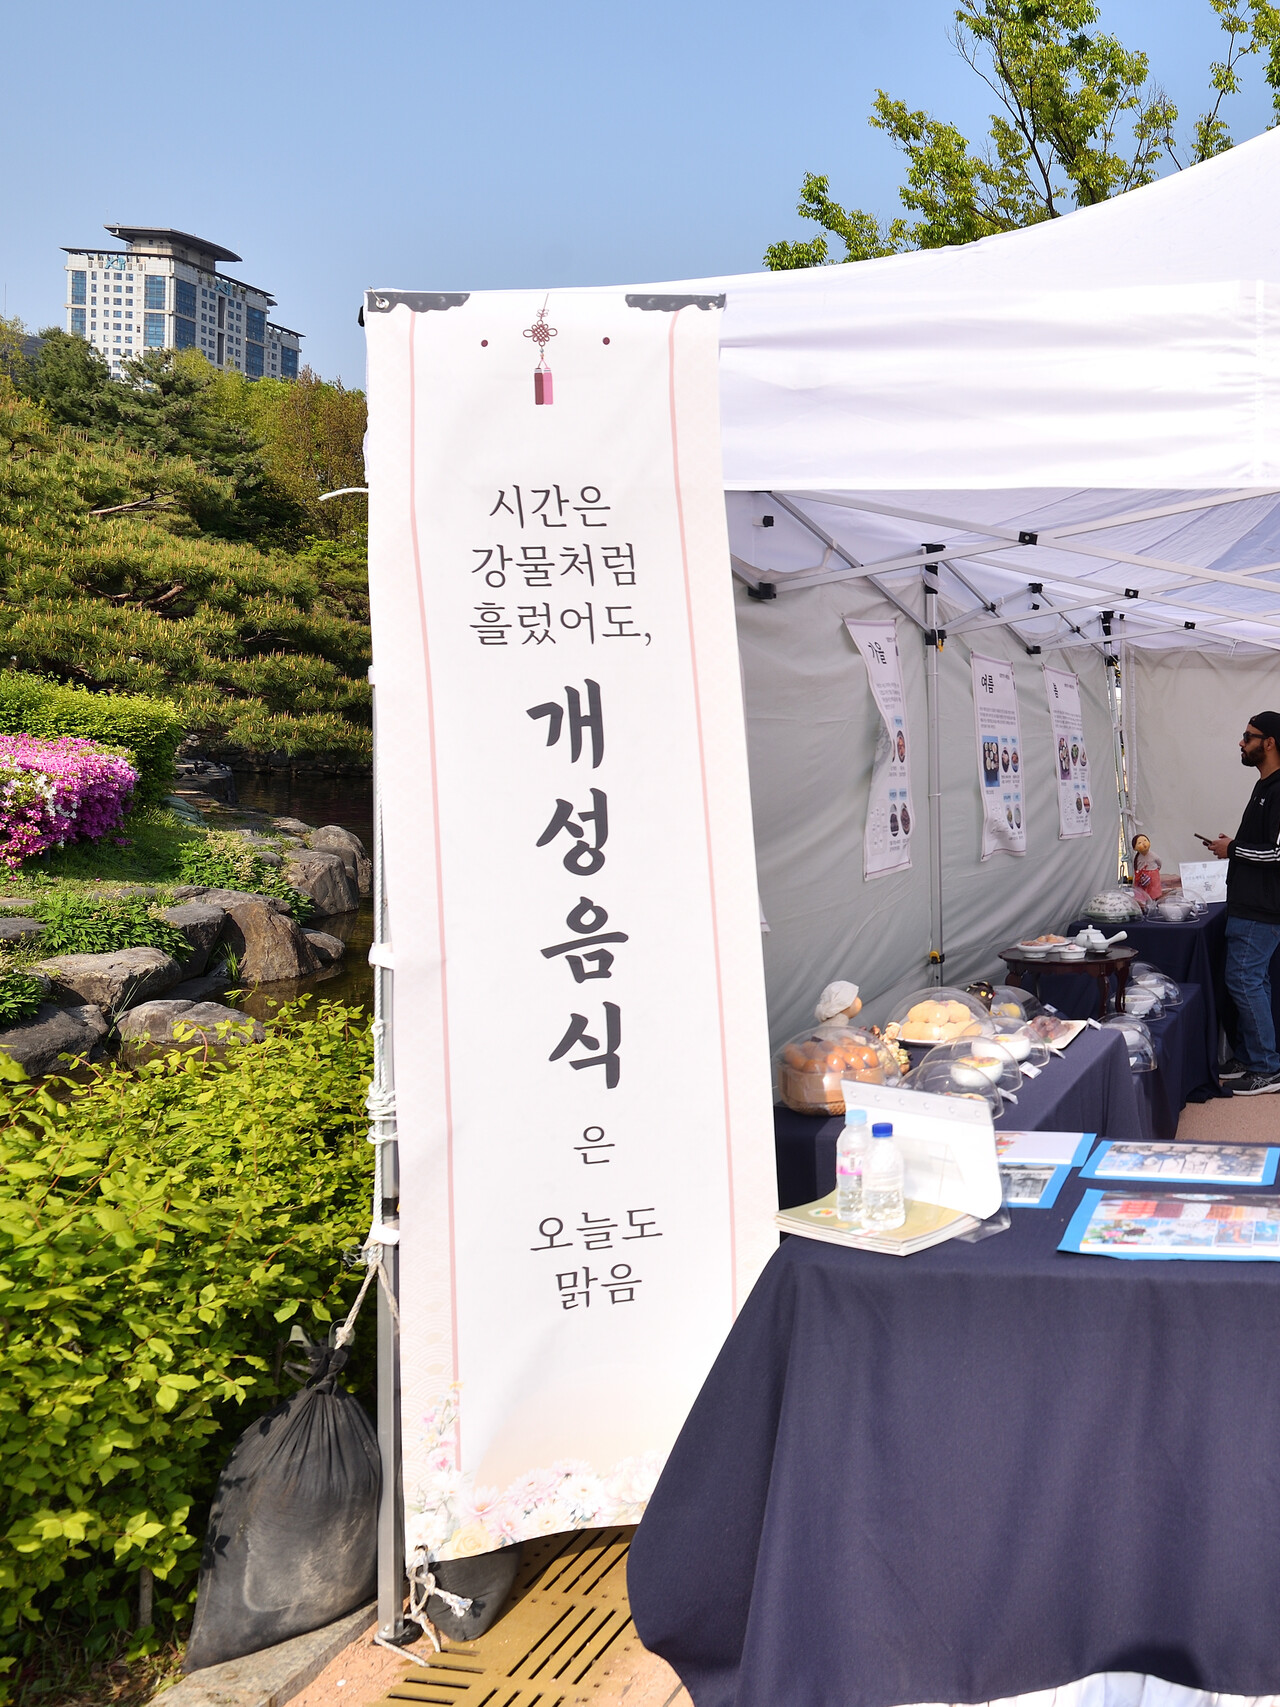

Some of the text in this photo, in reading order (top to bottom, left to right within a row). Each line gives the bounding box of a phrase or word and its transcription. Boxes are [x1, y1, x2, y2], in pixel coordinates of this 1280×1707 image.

[489, 485, 611, 528] 시간은
[471, 543, 637, 588] 강물처럼
[469, 603, 651, 646] 흘렀어도,
[525, 678, 629, 1089] 개성음식
[574, 1125, 615, 1164] 은
[531, 1208, 663, 1251] 오늘도
[556, 1264, 642, 1310] 맑음
